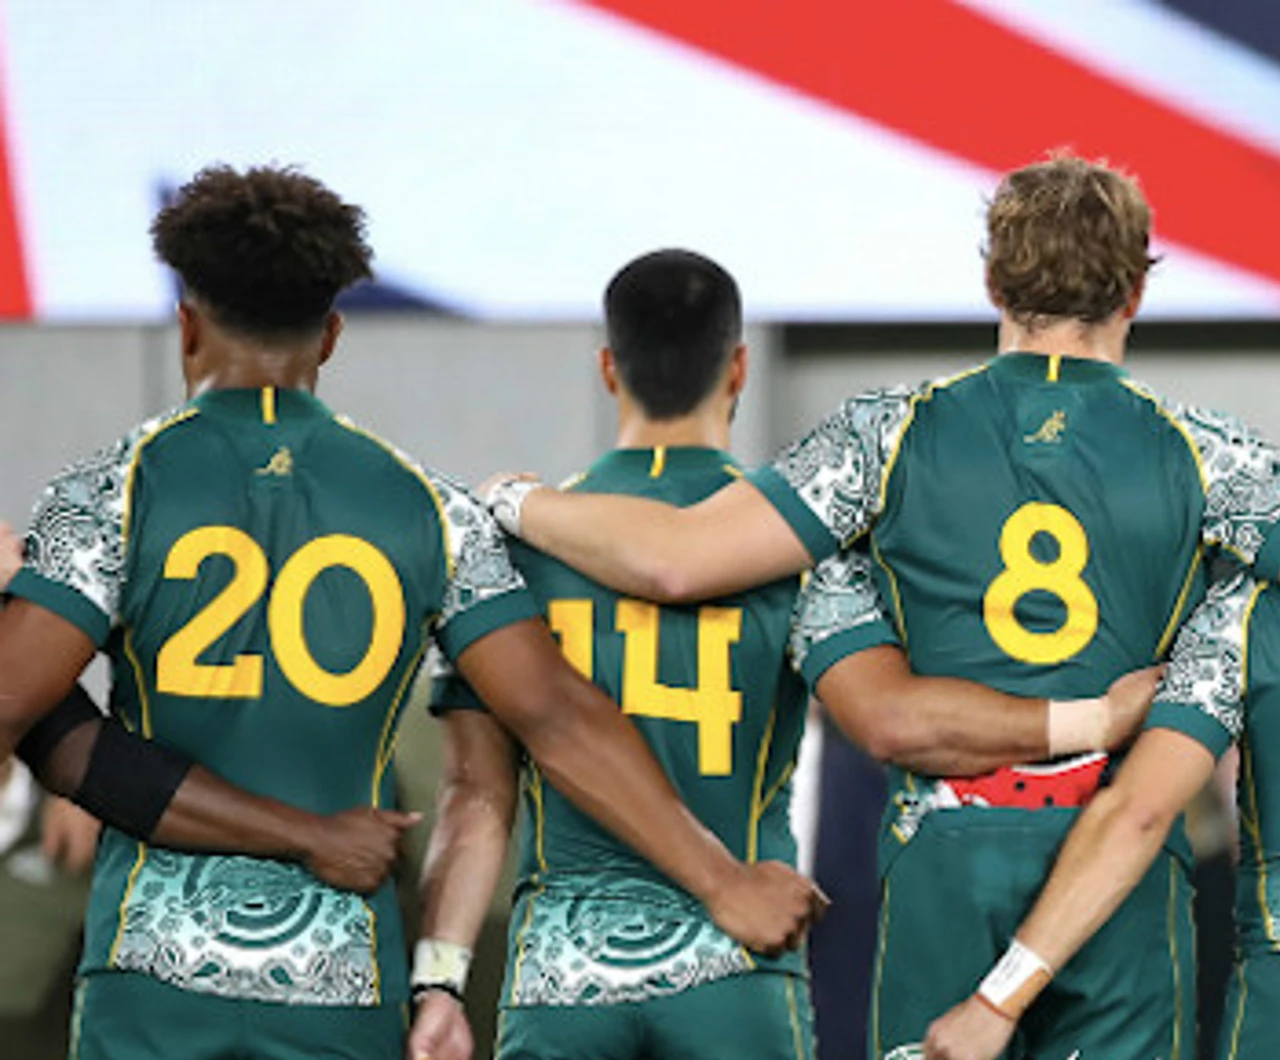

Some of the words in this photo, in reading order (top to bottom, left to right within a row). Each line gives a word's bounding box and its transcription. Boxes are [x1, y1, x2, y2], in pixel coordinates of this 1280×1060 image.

[155, 525, 406, 707] 20
[983, 502, 1098, 664] 8
[548, 598, 743, 776] 14
